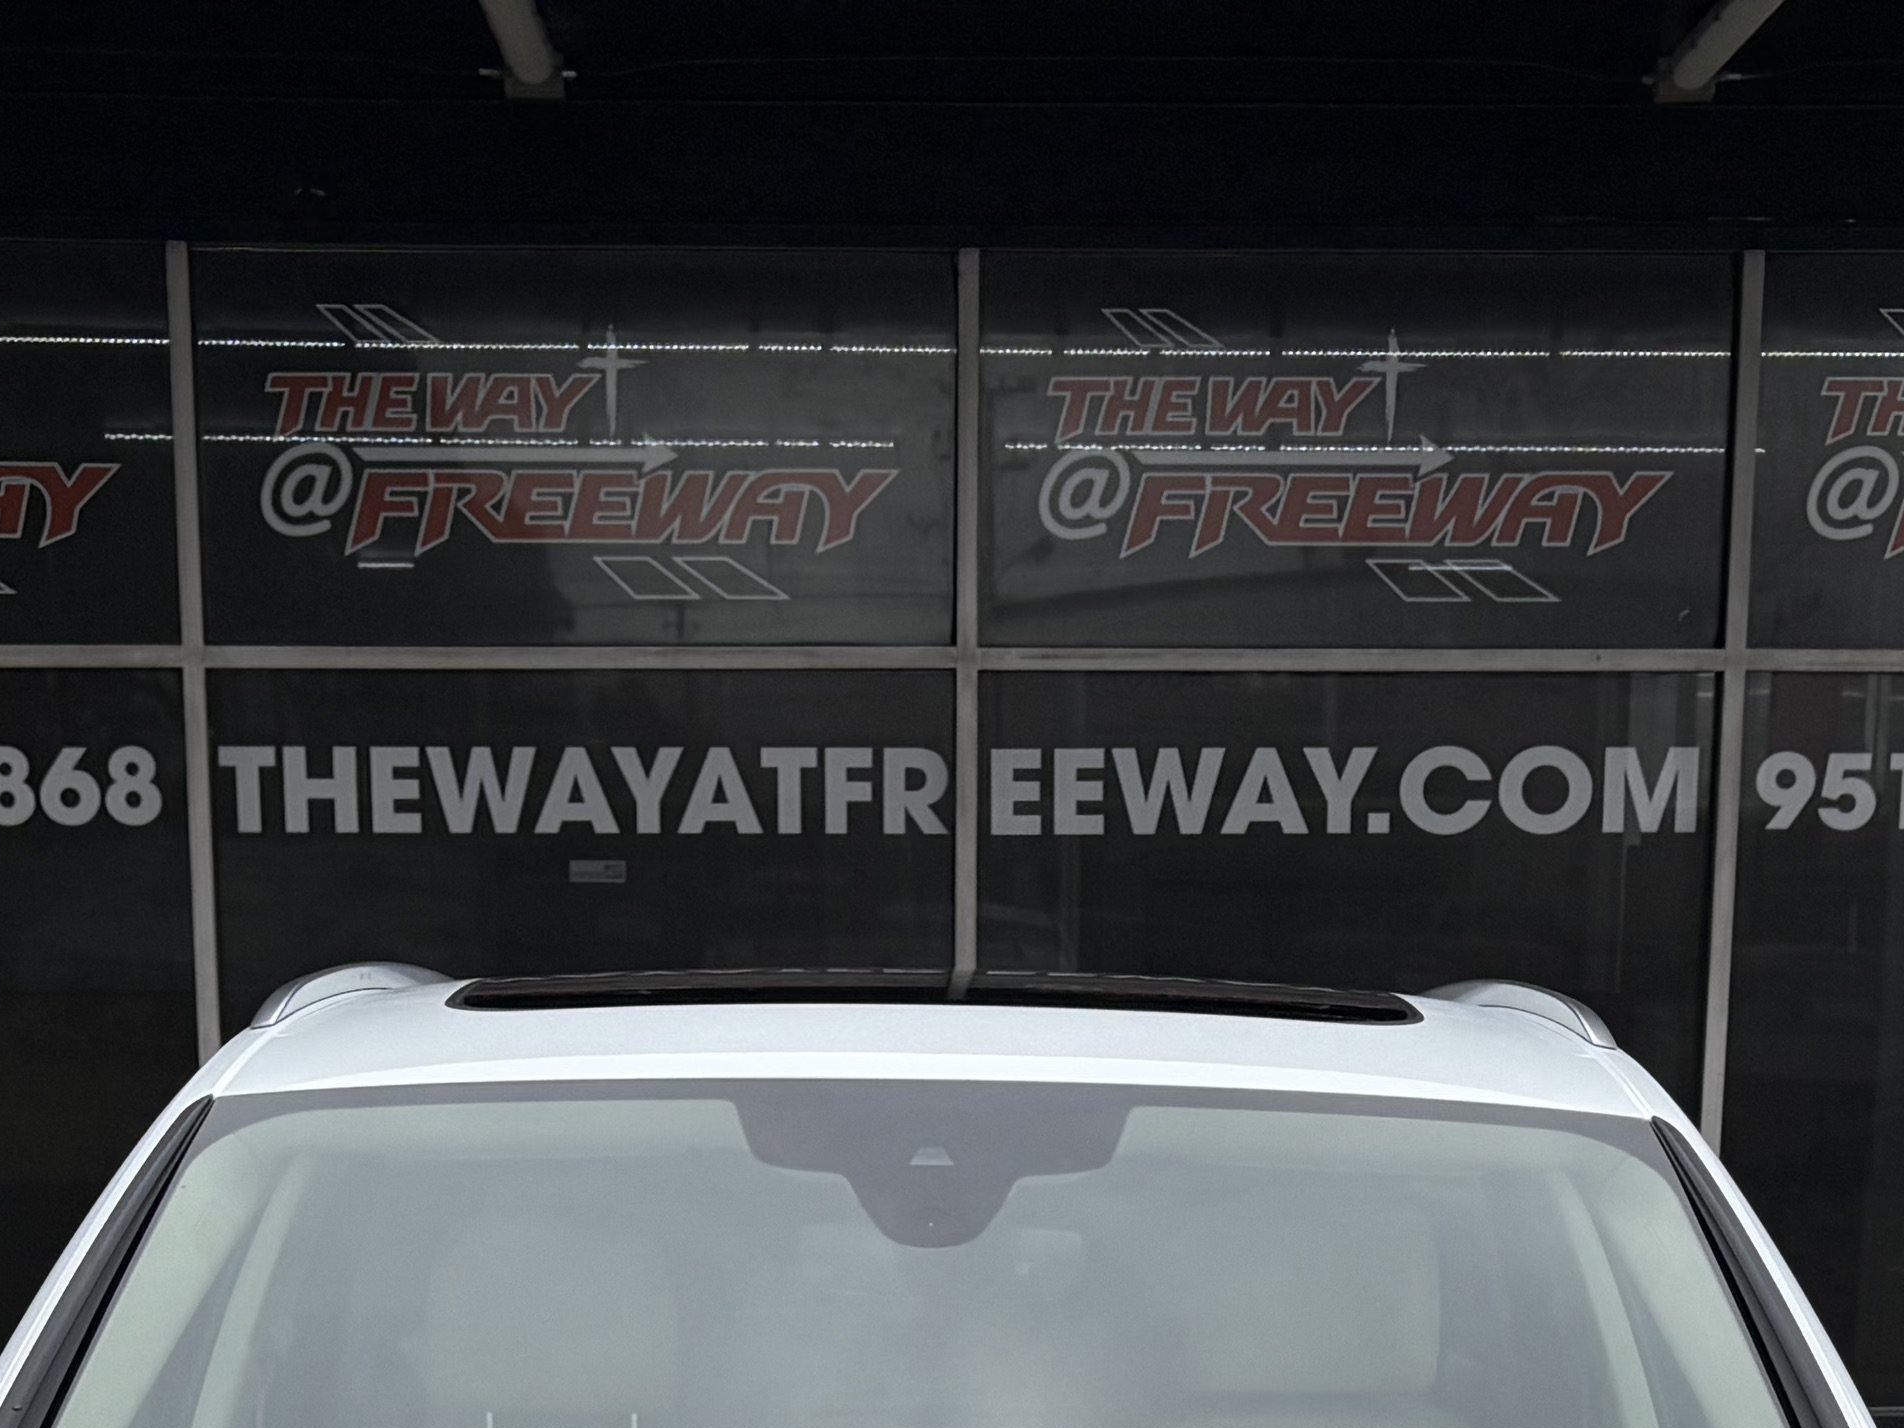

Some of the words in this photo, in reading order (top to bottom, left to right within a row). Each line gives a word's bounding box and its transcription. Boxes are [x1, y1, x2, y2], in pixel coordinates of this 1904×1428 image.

[264, 373, 419, 437] THE
[426, 373, 600, 433] WAY
[1047, 376, 1201, 442] THE
[1207, 377, 1381, 437] WAY
